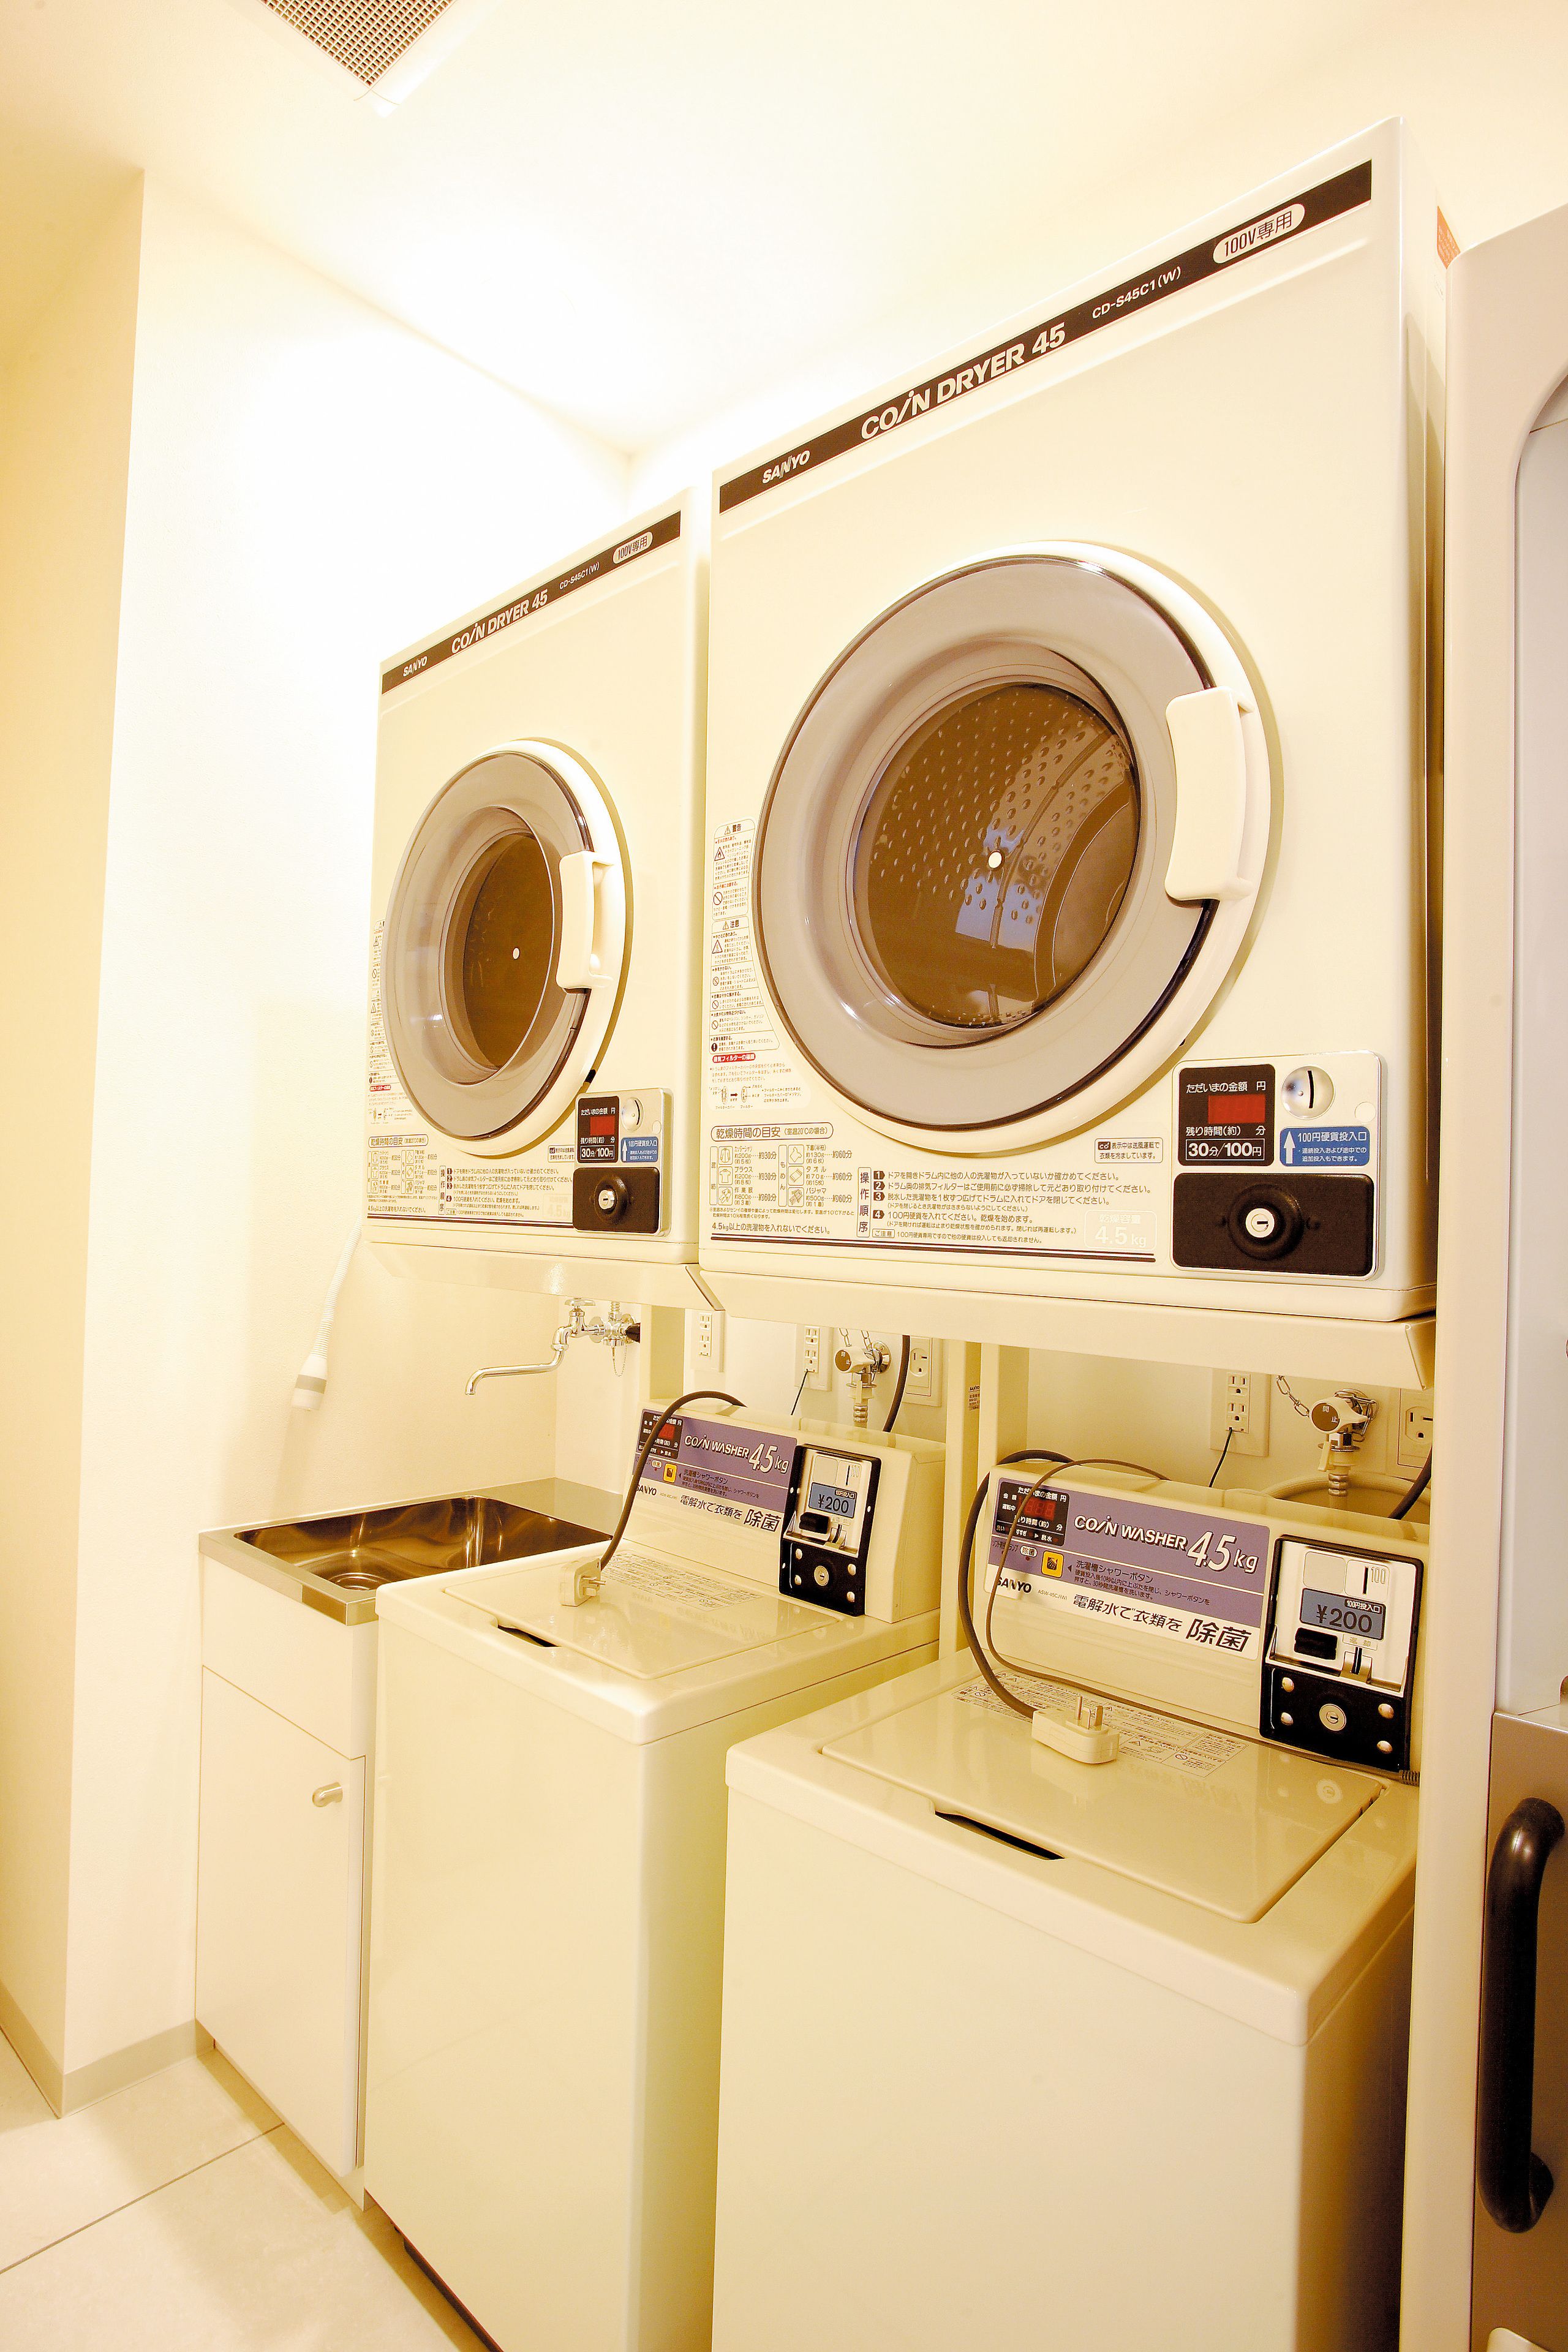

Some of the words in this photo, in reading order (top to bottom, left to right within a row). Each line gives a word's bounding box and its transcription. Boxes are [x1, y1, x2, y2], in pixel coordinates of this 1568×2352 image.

[1224, 210, 1294, 257] 100V専用
[763, 450, 810, 484] SANYO
[938, 344, 1025, 403] DRYER
[1032, 323, 1066, 354] 45
[1091, 267, 1182, 319] CD-S45C1(W)
[617, 535, 648, 560] 100V専用
[403, 656, 428, 677] SANYO
[488, 601, 529, 635] DRYER
[533, 589, 548, 609] 45
[560, 562, 600, 590] CD-S45C1(W)
[1186, 1081, 1248, 1093] ただいまの金額
[1256, 1080, 1266, 1091] 円
[716, 1127, 780, 1139] 乾燥時間の目安
[1256, 1125, 1265, 1136] 分
[1298, 1131, 1366, 1142] 100円硬貨投入口
[582, 1147, 613, 1158] 30分/100円
[1188, 1142, 1262, 1156] 30分/100円
[859, 1172, 869, 1232] 操作順序
[712, 1222, 829, 1234] 4.5kg以上の洗濯物を入れないでください。
[1095, 1226, 1128, 1245] 4.5
[1131, 1234, 1147, 1248] kg
[712, 1442, 750, 1458] WASHER
[680, 1494, 742, 1520] 電解水で衣類を
[744, 1509, 782, 1532] 除菌
[818, 1494, 849, 1513] ¥200
[1121, 1524, 1188, 1551] WASHER
[1076, 1559, 1153, 1583] 洗濯槽シャワーボタン
[1371, 1567, 1386, 1585] 100
[997, 1577, 1032, 1593] SANYO
[1072, 1594, 1183, 1632] 電解水で衣類を
[1186, 1618, 1252, 1652] 除菌
[1316, 1604, 1372, 1634] ¥200
